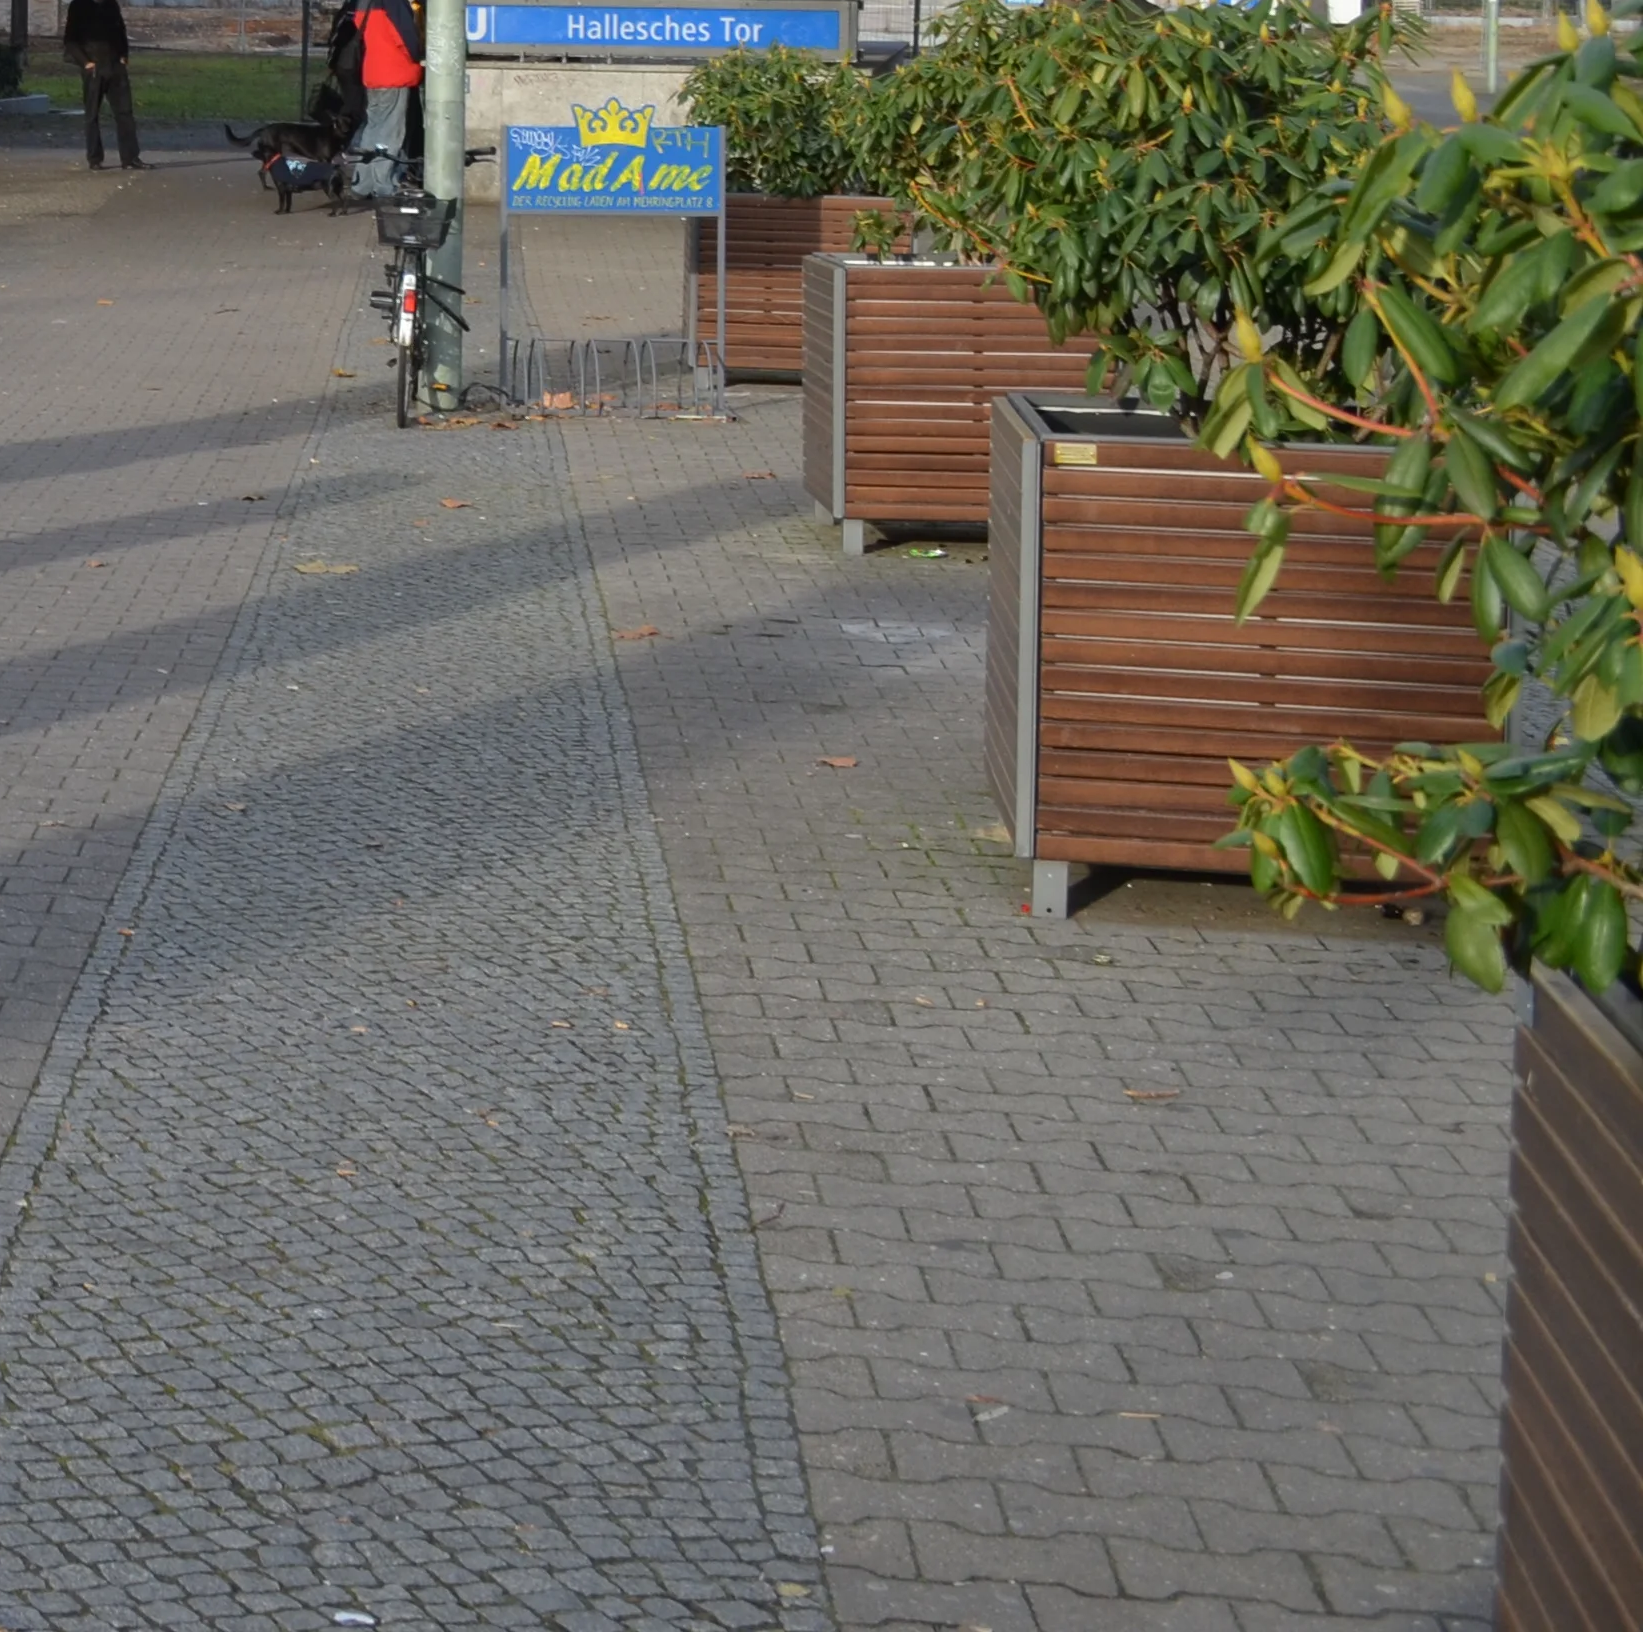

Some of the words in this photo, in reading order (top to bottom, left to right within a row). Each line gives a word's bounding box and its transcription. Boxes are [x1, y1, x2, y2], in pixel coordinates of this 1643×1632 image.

[567, 13, 711, 42] Hallesches
[719, 16, 763, 43] Tor
[512, 195, 533, 207] DER
[633, 196, 703, 208] MEHRINGPLATZ
